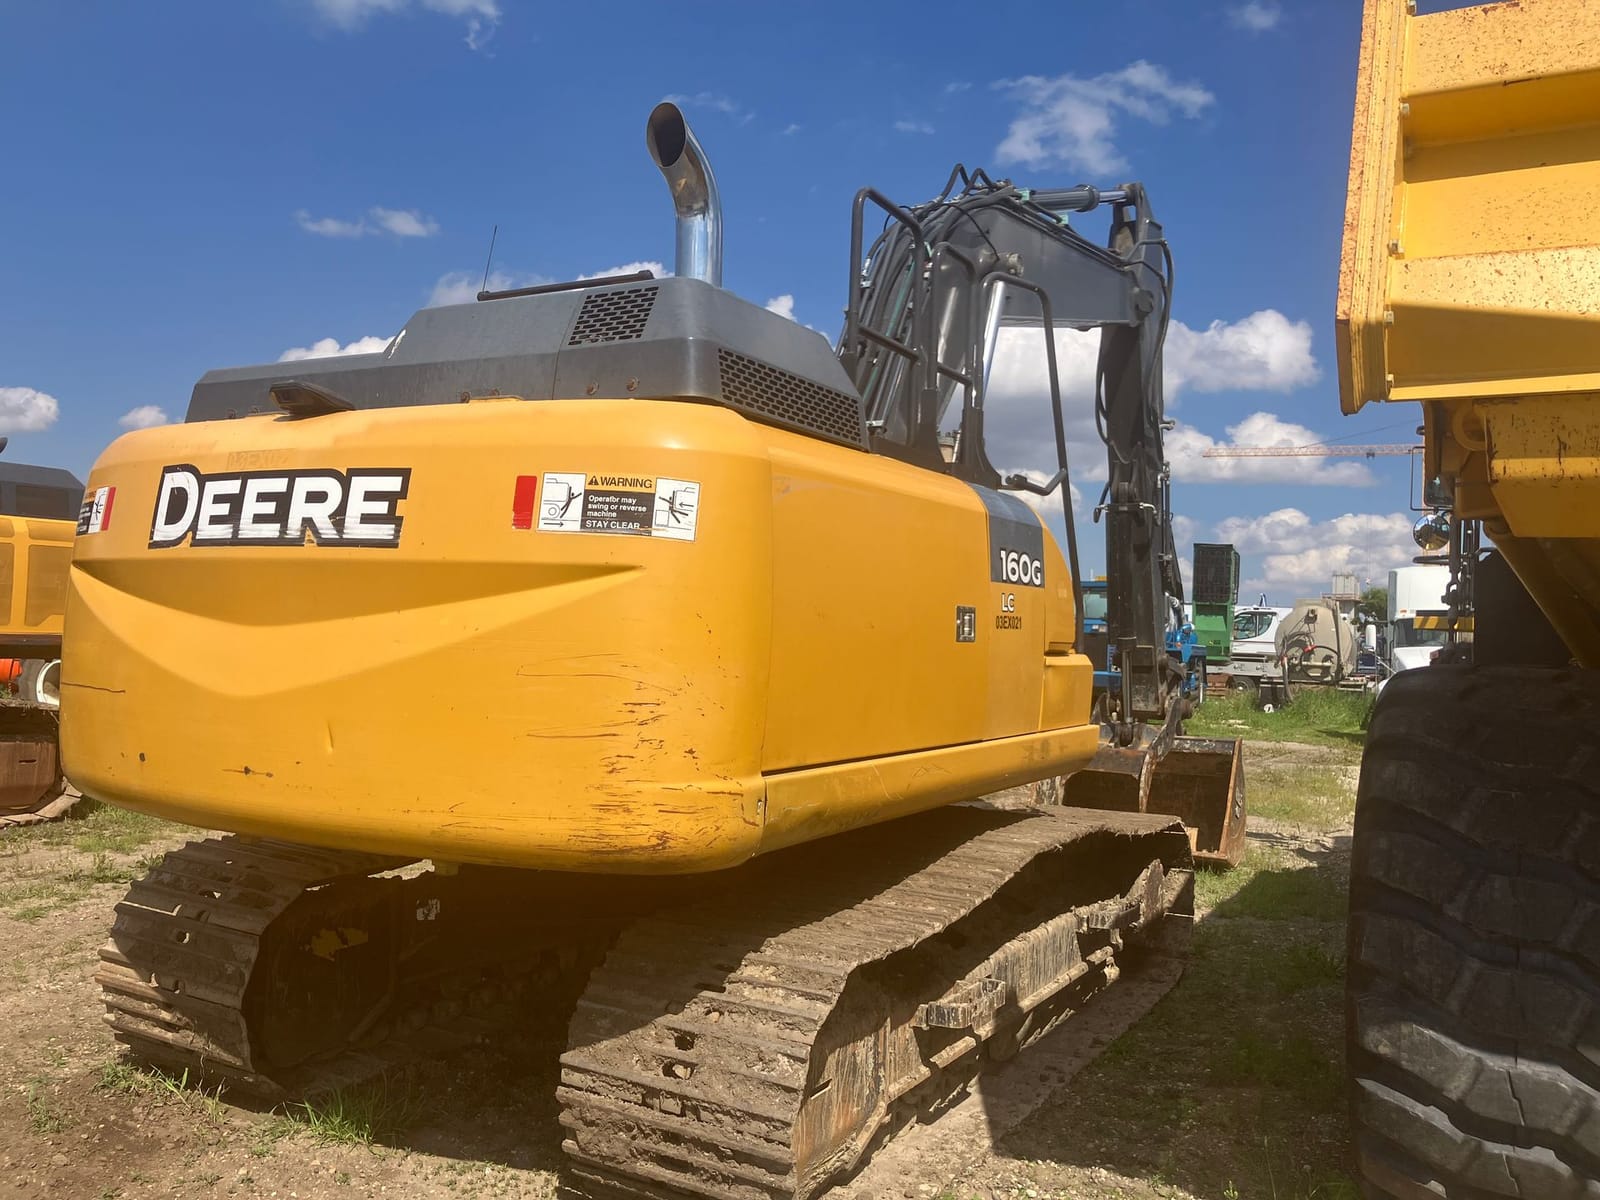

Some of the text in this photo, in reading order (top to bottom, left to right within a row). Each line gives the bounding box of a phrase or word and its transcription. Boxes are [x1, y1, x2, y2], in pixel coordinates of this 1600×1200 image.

[600, 477, 653, 489] WARNING
[588, 494, 637, 505] Operator may
[152, 468, 406, 544] DEERE
[587, 502, 609, 512] swing
[620, 504, 647, 513] reverse
[586, 510, 617, 518] machine
[585, 520, 640, 530] STAY CLEAR
[999, 549, 1042, 586] 160G
[1001, 593, 1015, 612] LC
[995, 615, 1022, 630] 03EX021
